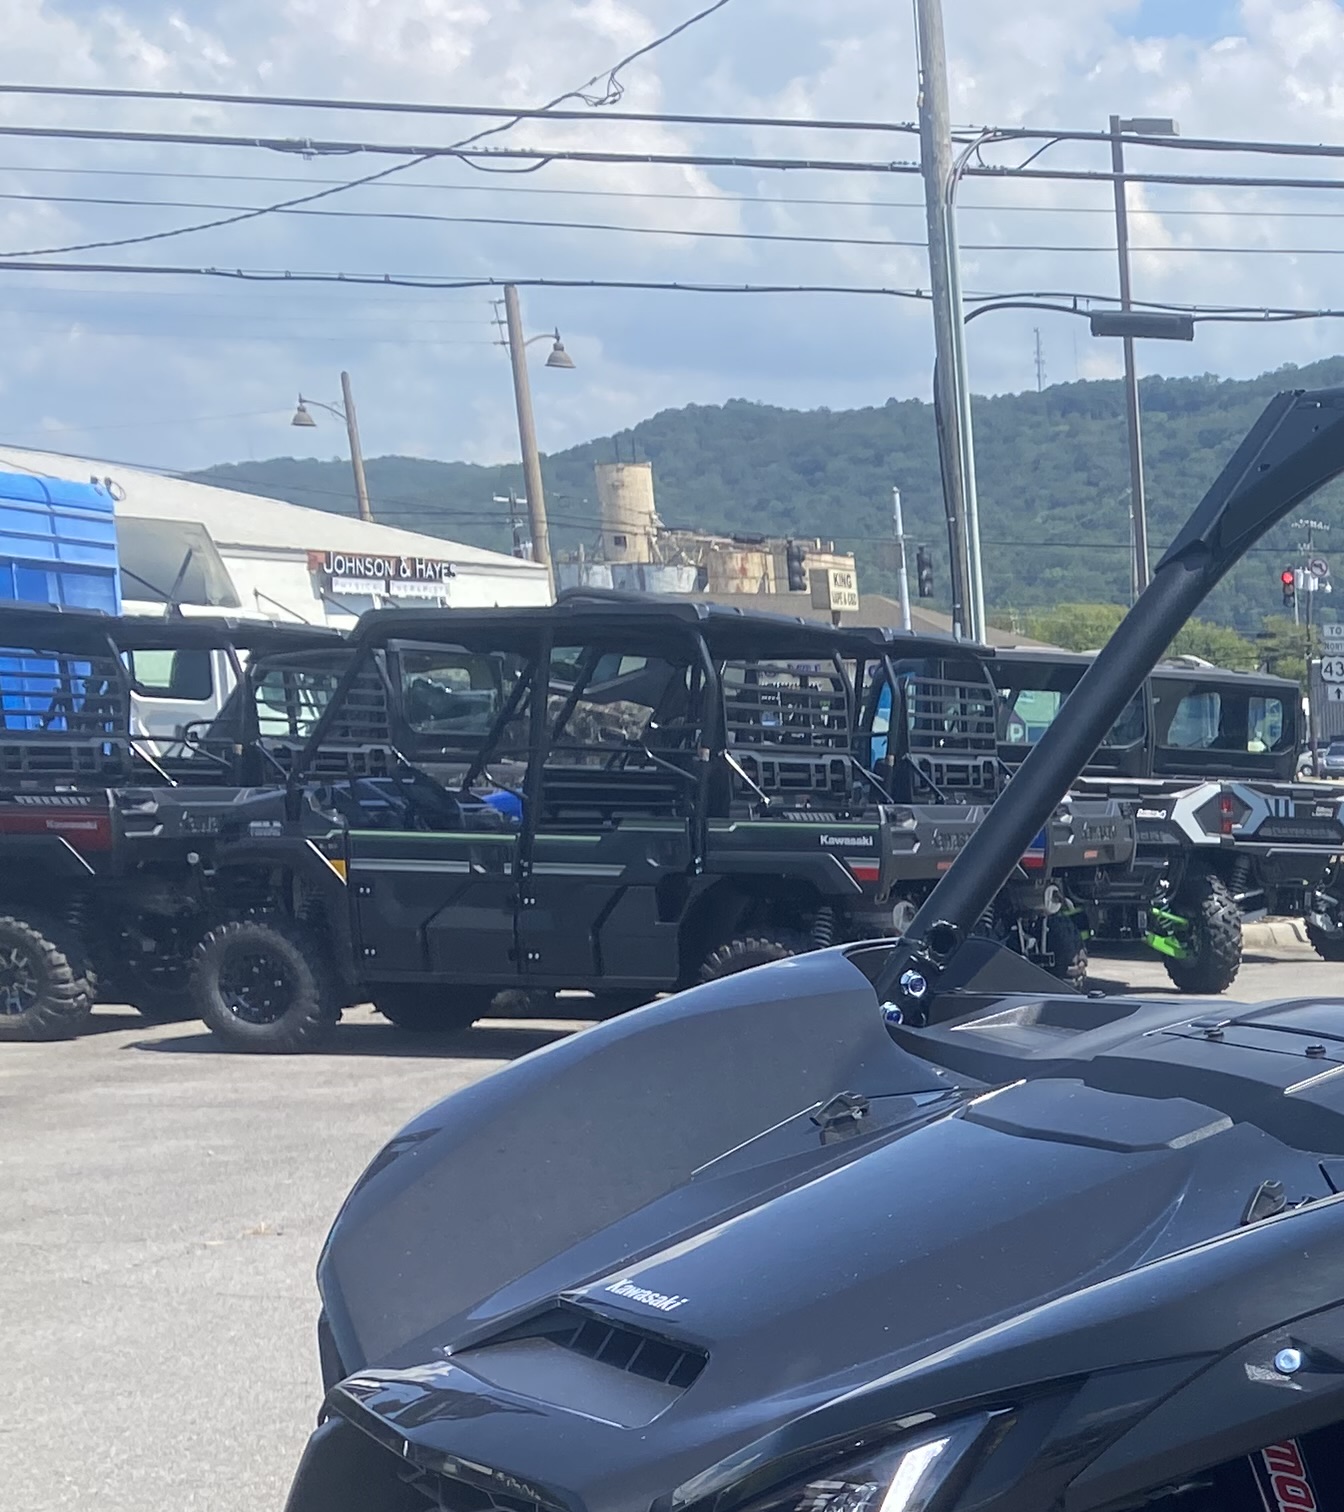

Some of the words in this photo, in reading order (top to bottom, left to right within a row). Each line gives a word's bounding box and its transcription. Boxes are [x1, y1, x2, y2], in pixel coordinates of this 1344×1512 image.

[323, 551, 393, 577] JOHNSON
[400, 557, 411, 578] &
[415, 558, 457, 580] HAYES
[1329, 626, 1343, 635] TO
[820, 834, 873, 847] Kawasaki
[604, 1279, 689, 1312] Kawasaki
